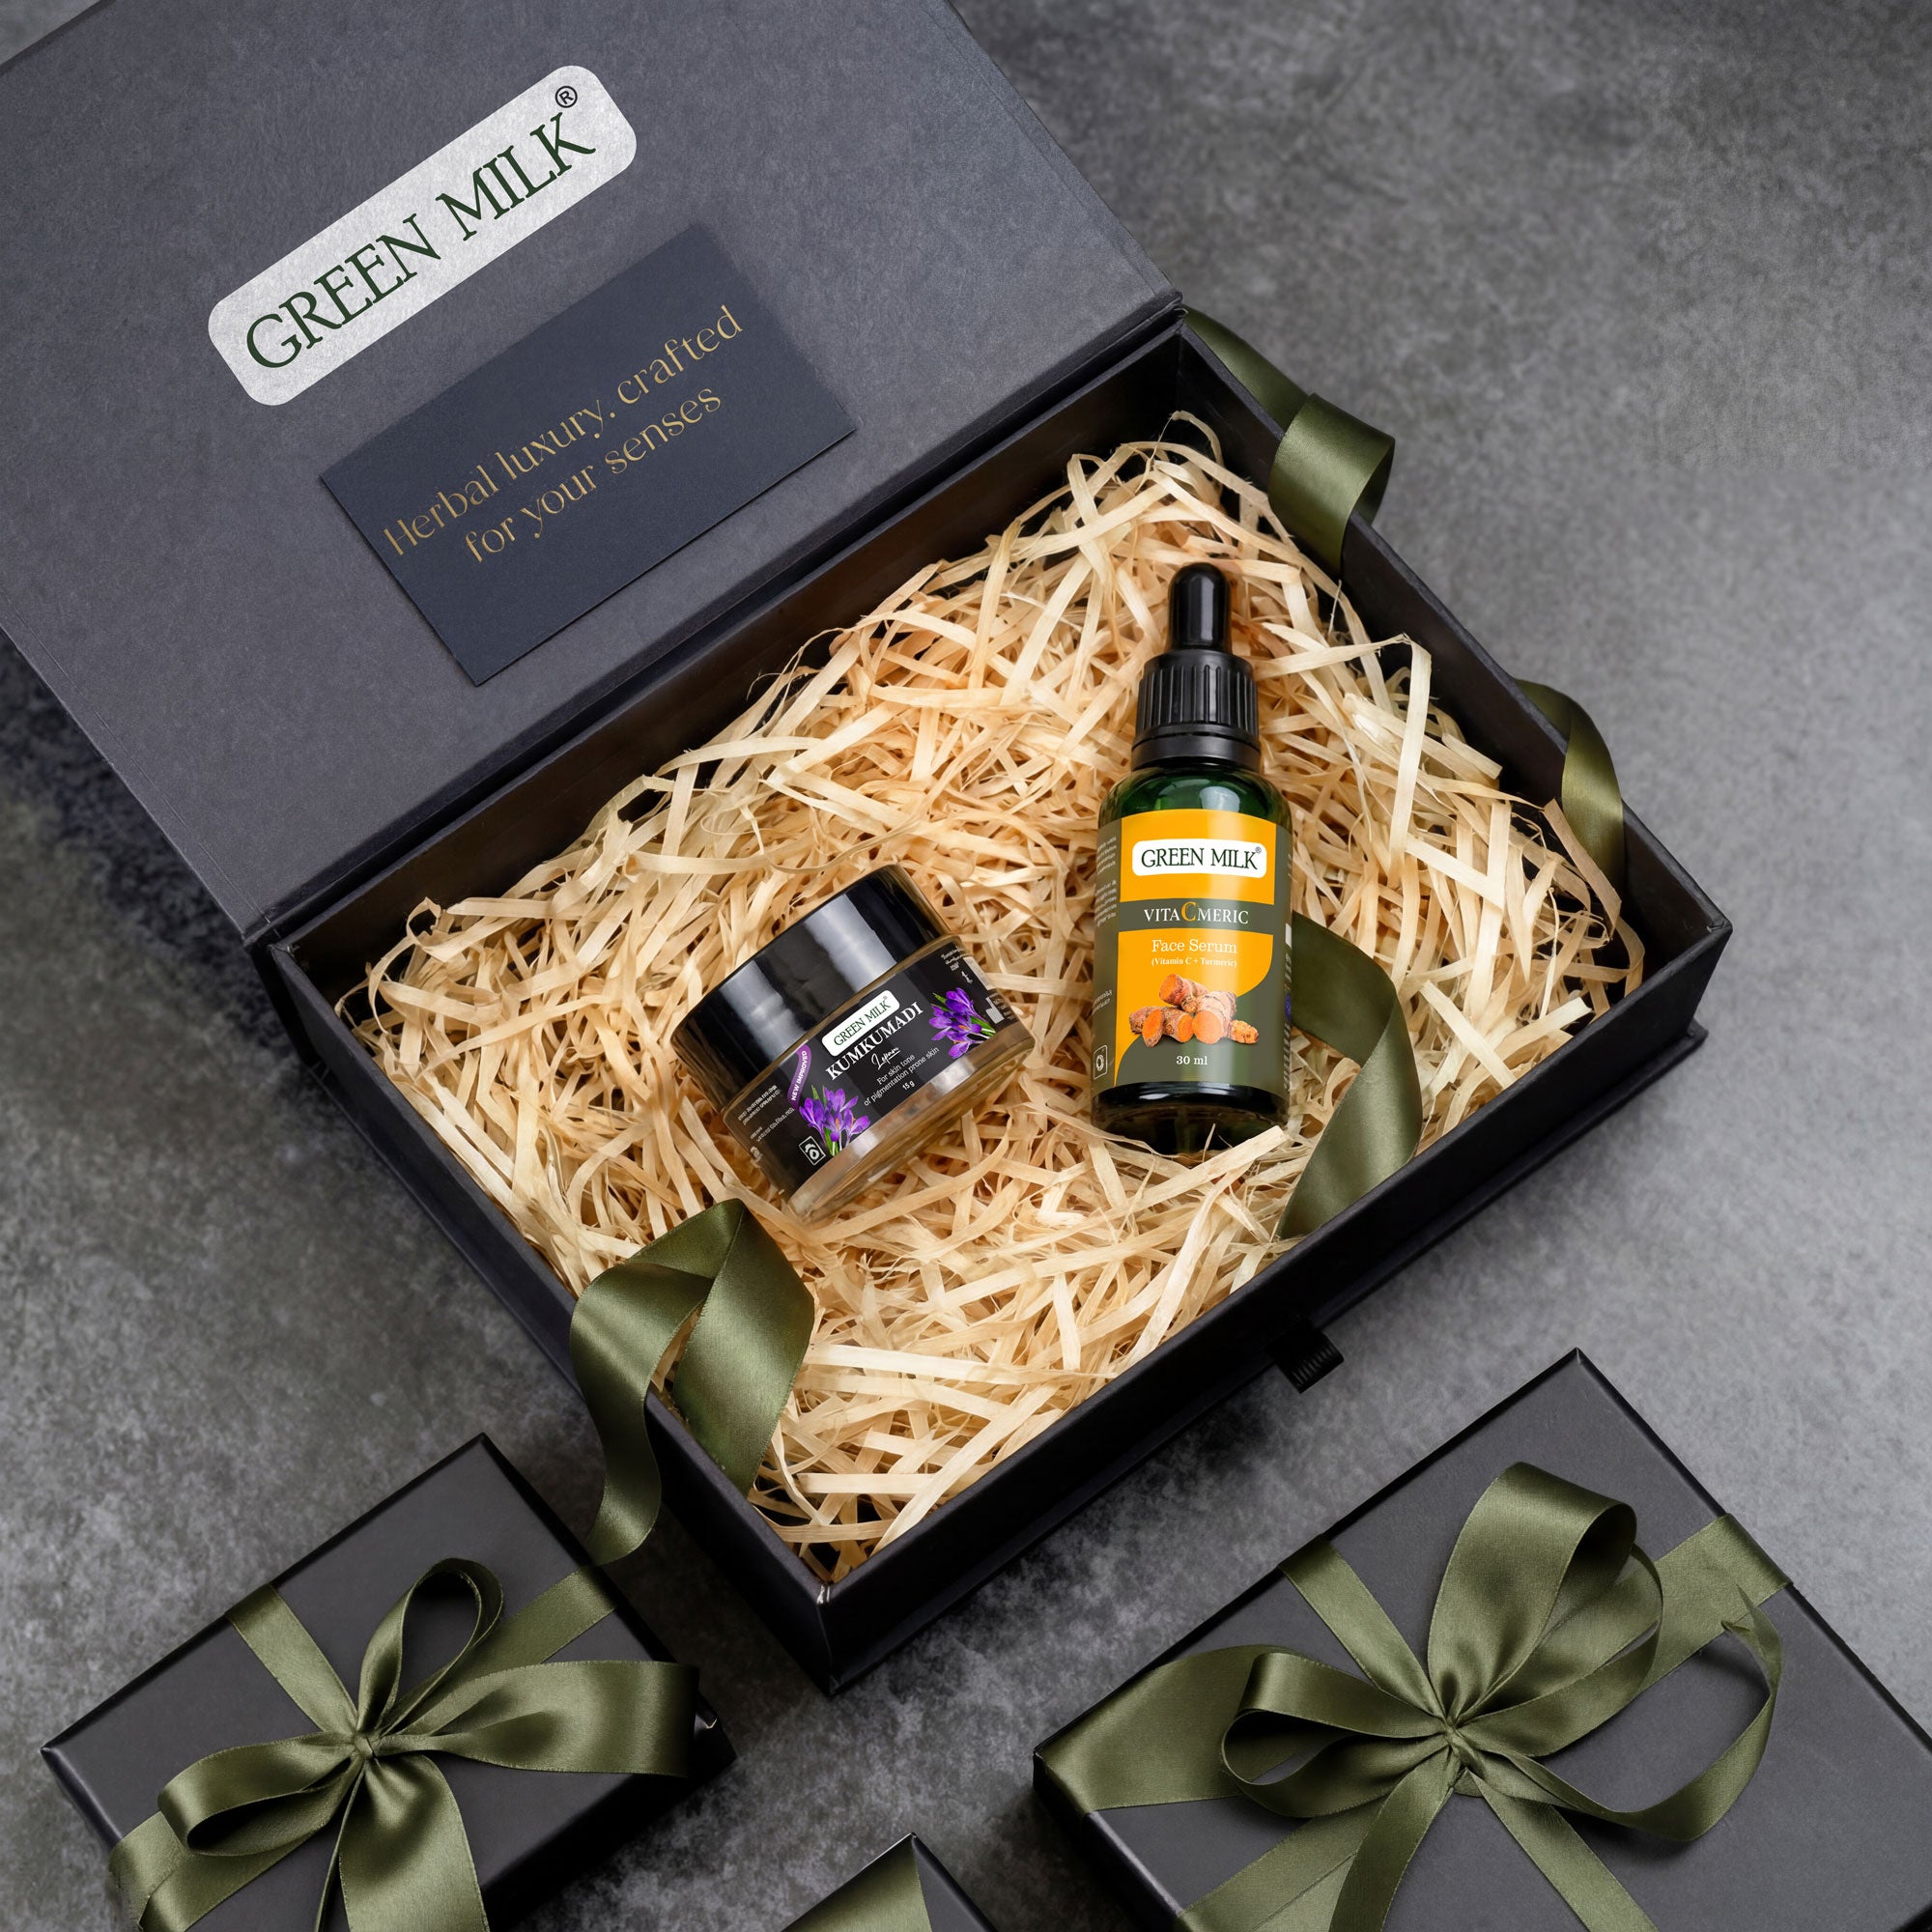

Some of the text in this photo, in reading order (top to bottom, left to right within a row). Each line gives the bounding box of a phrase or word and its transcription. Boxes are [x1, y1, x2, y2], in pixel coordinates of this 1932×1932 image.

[246, 213, 441, 368] GREEN
[384, 304, 743, 555] Herbal luxury. crafted
[465, 388, 722, 563] for your senses
[1141, 847, 1205, 868] GREEN
[1143, 901, 1249, 924] VITACMERIC
[1151, 938, 1237, 953] Face Serum
[1151, 957, 1183, 966] (Vitamin
[1201, 957, 1237, 968] Turmeric)
[825, 1001, 923, 1081] KUMKUMADI
[834, 1017, 867, 1046] GREEN
[791, 1050, 808, 1101] NEW IMPROVED
[877, 1054, 916, 1085] For skin tone
[1176, 1055, 1208, 1065] 30 ml
[864, 1047, 940, 1106] of pigmentation prone skin
